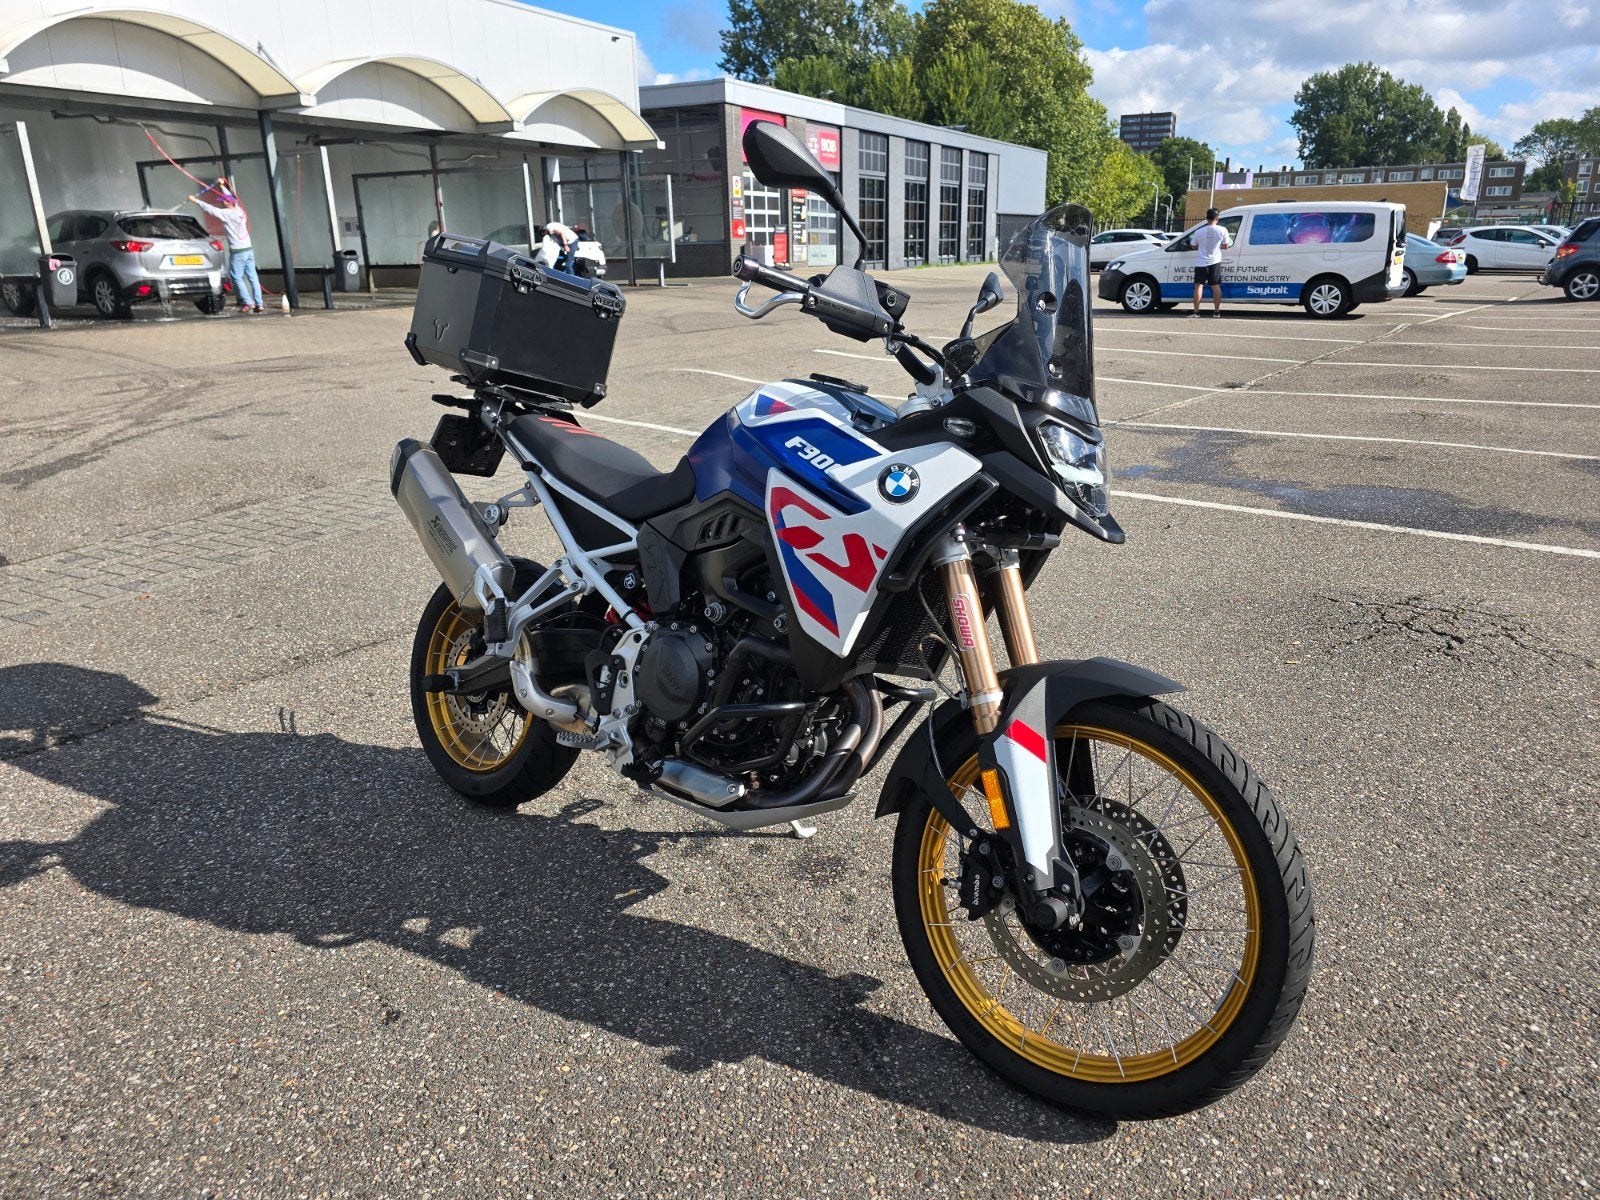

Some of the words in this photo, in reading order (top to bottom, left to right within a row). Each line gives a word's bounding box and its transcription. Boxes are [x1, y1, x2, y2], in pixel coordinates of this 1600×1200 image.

[1247, 285, 1288, 296] Saybolt
[891, 465, 919, 487] BMW
[952, 598, 975, 647] SHOWA
[972, 874, 980, 905] brembo
